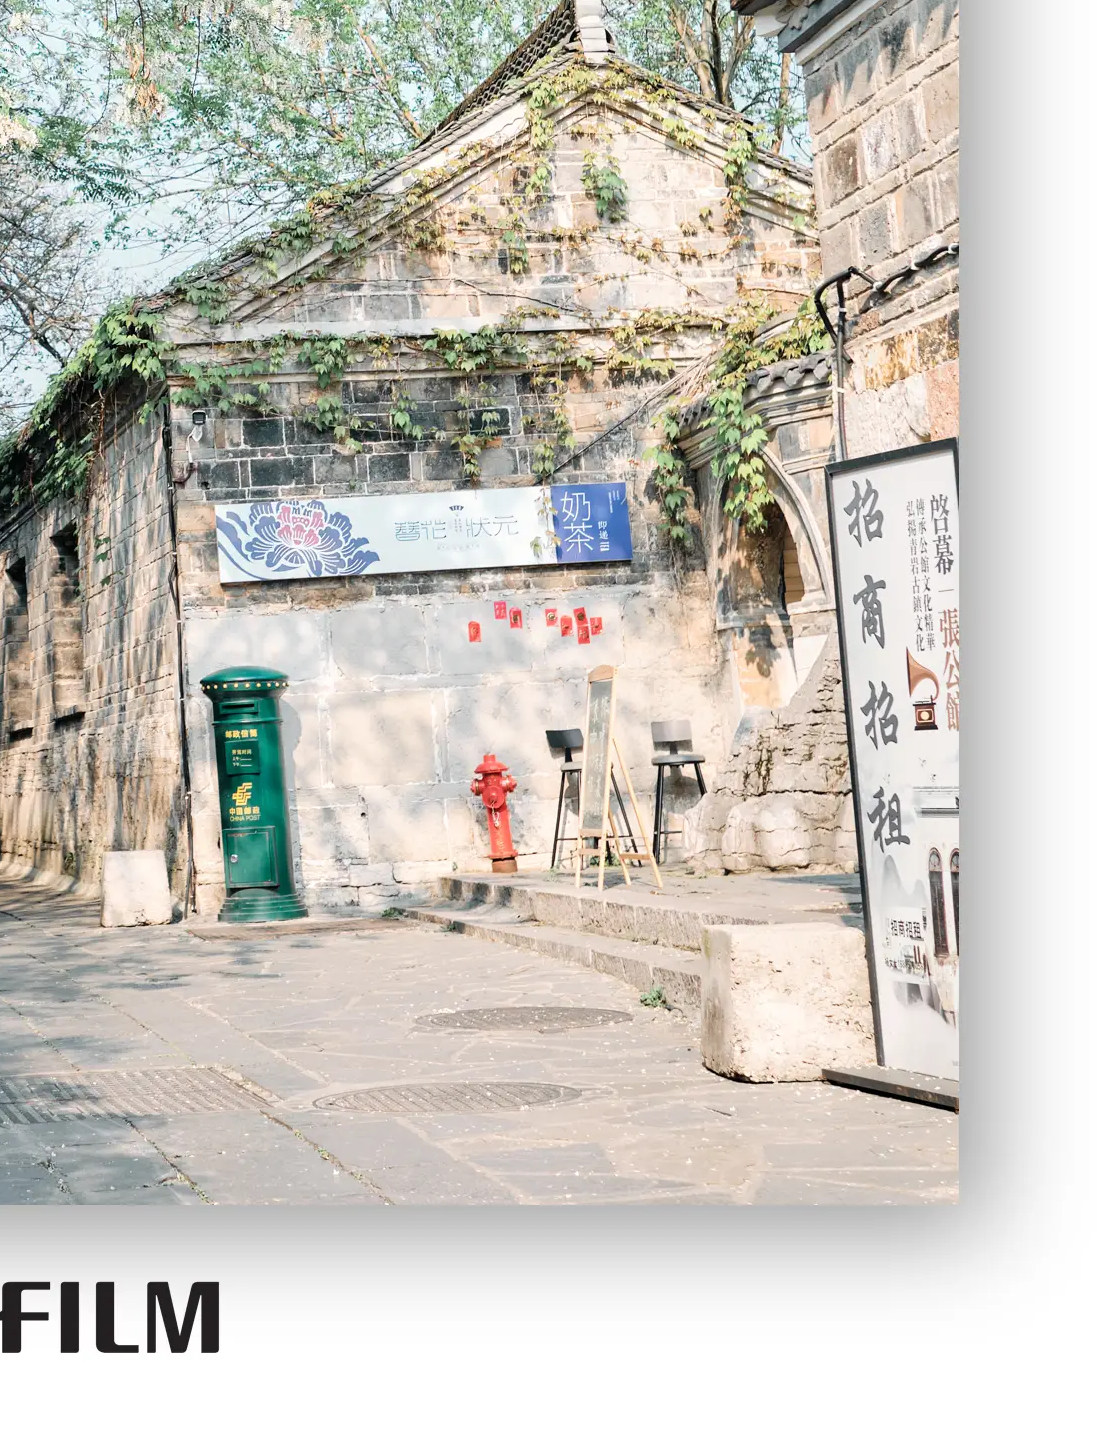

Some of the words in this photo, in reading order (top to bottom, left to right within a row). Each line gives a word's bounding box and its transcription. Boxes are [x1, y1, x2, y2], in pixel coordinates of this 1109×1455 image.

[560, 491, 595, 553] 奶茶
[843, 477, 911, 854] 招商招租
[245, 813, 261, 821] POST
